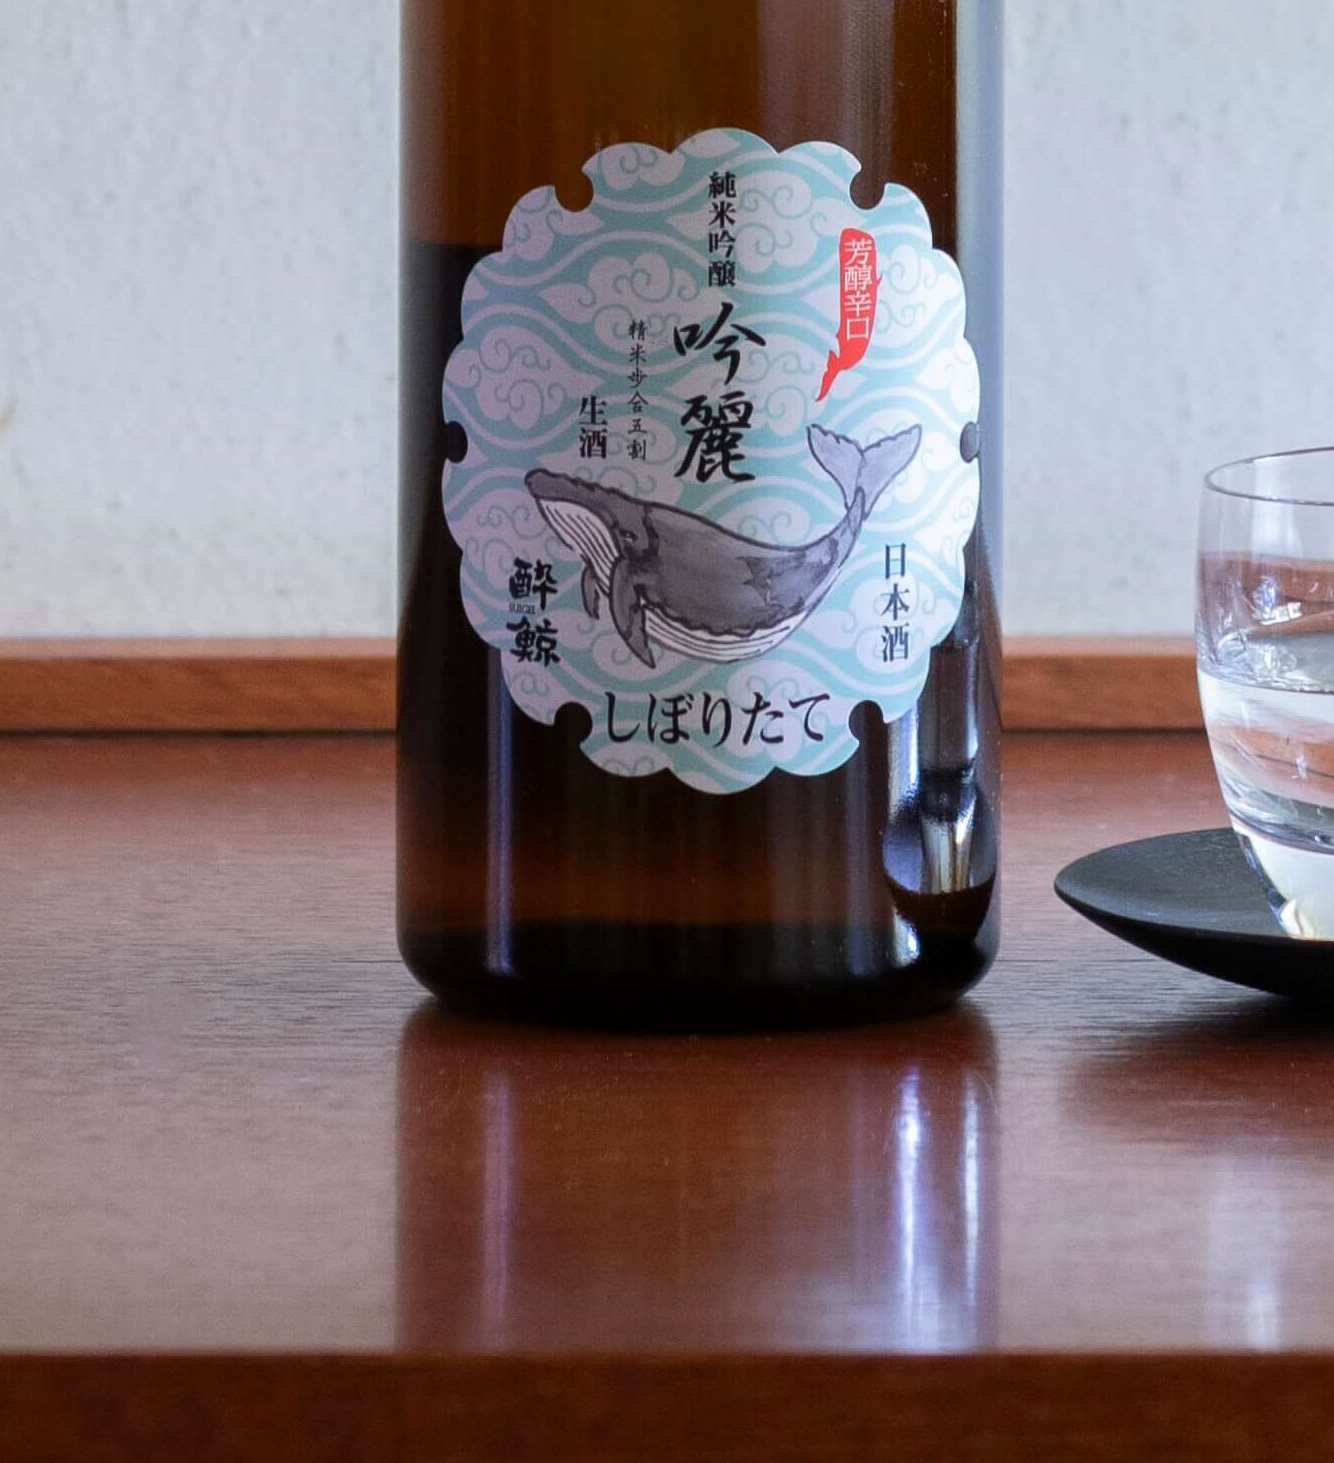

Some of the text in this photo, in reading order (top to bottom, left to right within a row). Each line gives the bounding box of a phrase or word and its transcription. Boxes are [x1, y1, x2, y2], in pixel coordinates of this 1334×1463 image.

[708, 171, 736, 287] 純米吟醸
[844, 238, 872, 340] 芳醇辛口
[578, 395, 608, 459] 生酒
[627, 320, 648, 461] 精米歩合五割
[673, 302, 766, 483] 吟麗
[506, 556, 561, 667] 酔鯨
[880, 542, 910, 662] 日本酒
[605, 691, 831, 748] しぼりたて
